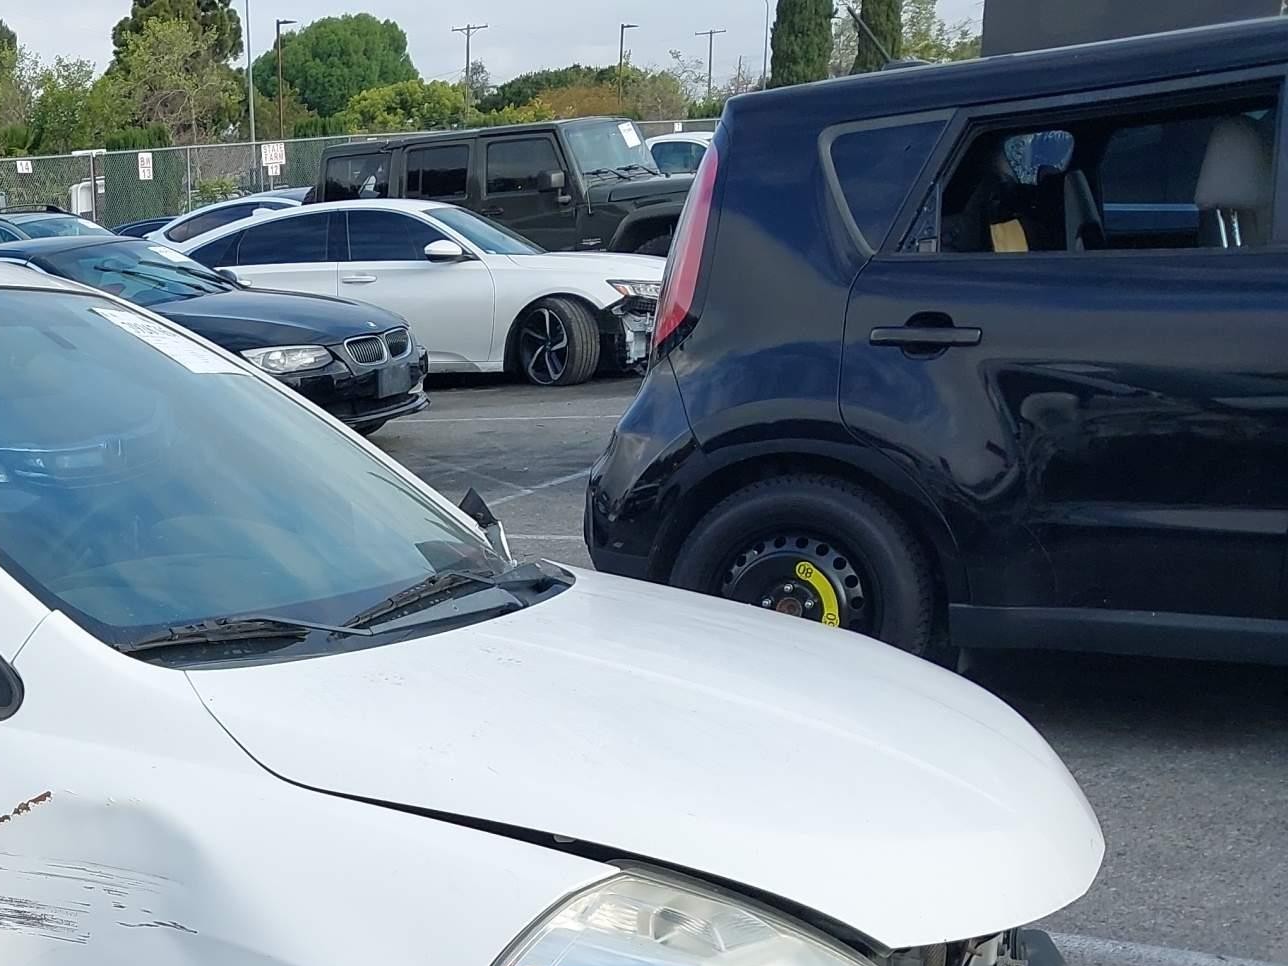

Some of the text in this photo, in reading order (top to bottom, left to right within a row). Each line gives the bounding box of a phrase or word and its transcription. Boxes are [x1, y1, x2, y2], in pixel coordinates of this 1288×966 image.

[263, 143, 284, 153] STATE
[264, 152, 284, 162] FARM
[19, 161, 30, 173] 14
[270, 164, 279, 175] 12
[142, 168, 152, 179] 13
